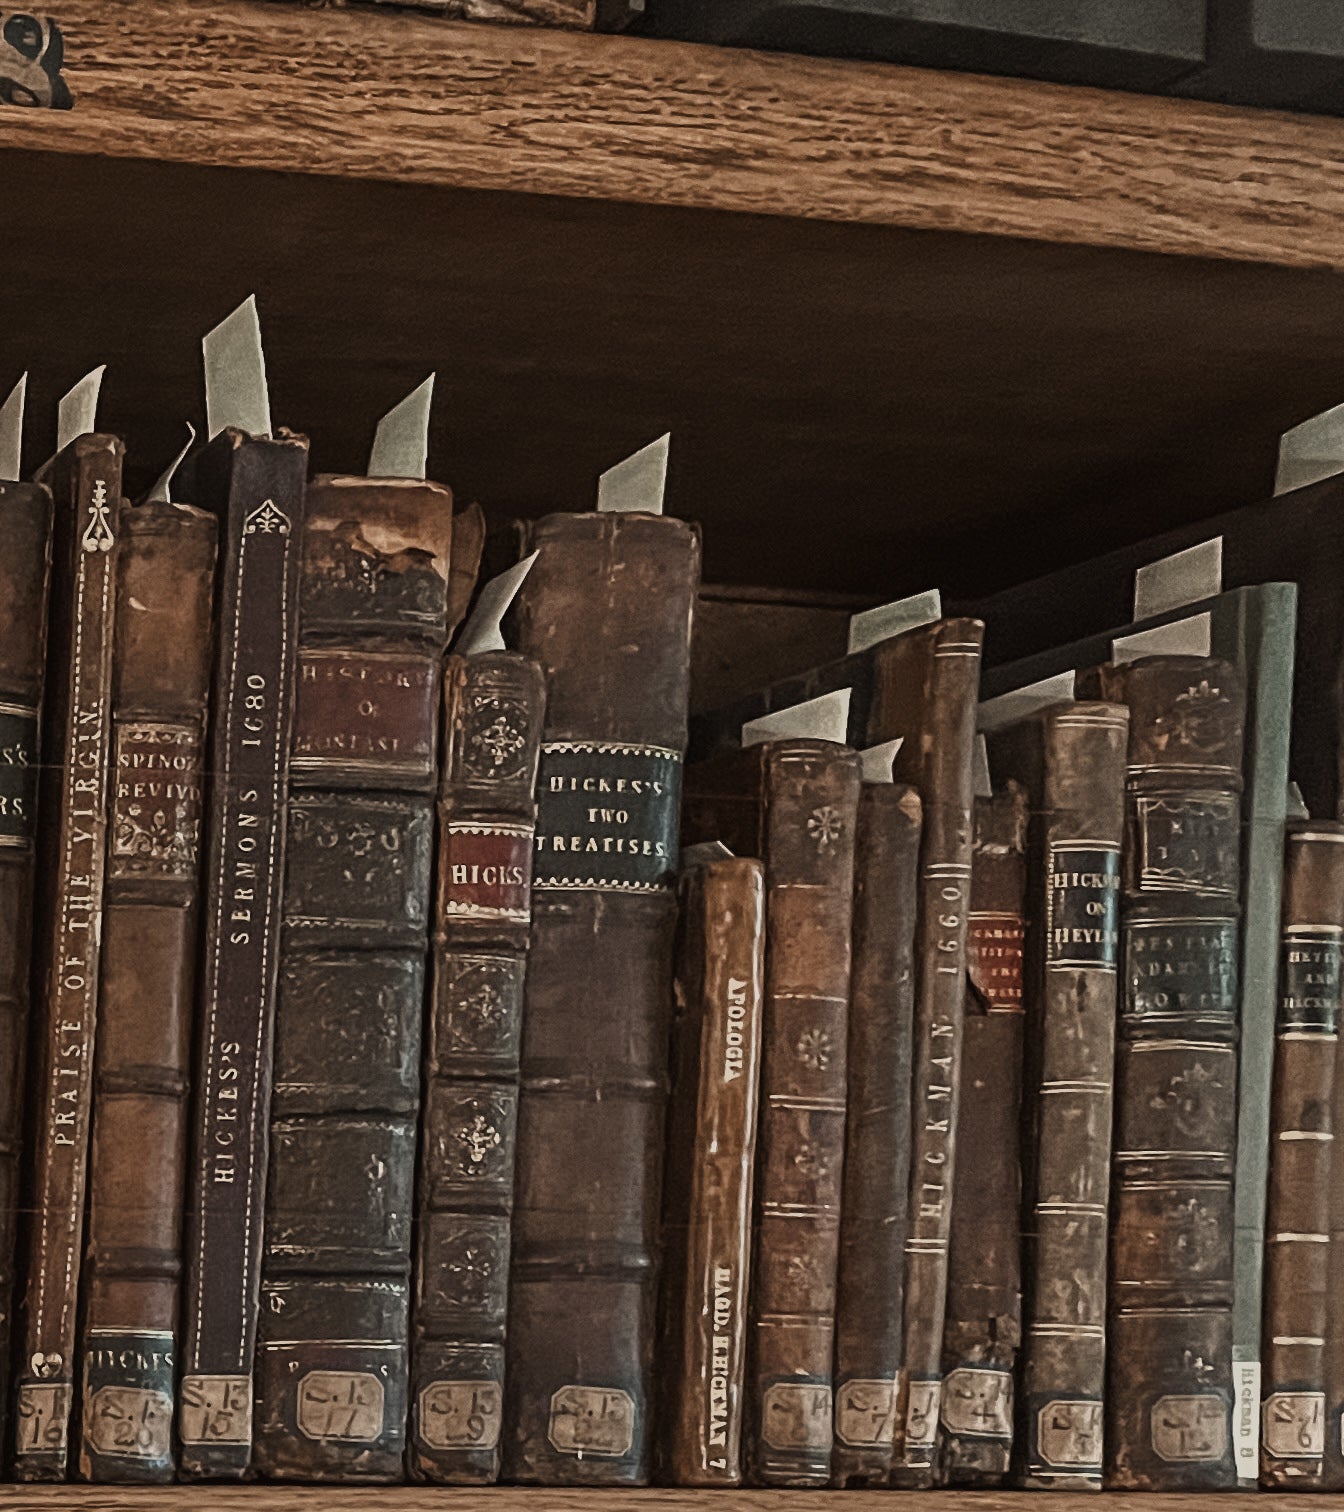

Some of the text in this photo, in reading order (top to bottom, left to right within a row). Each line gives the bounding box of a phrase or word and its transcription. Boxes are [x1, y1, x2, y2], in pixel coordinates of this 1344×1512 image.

[244, 674, 267, 749] 1680
[549, 775, 664, 797] HICKES'S
[588, 807, 629, 825] TWO
[230, 788, 260, 944] SERMONS
[536, 837, 667, 859] TREATISES
[53, 699, 101, 1146] PRAISE OF THE VIRGIN.
[940, 885, 962, 975] 1660
[723, 977, 747, 1084] APOLOGIA
